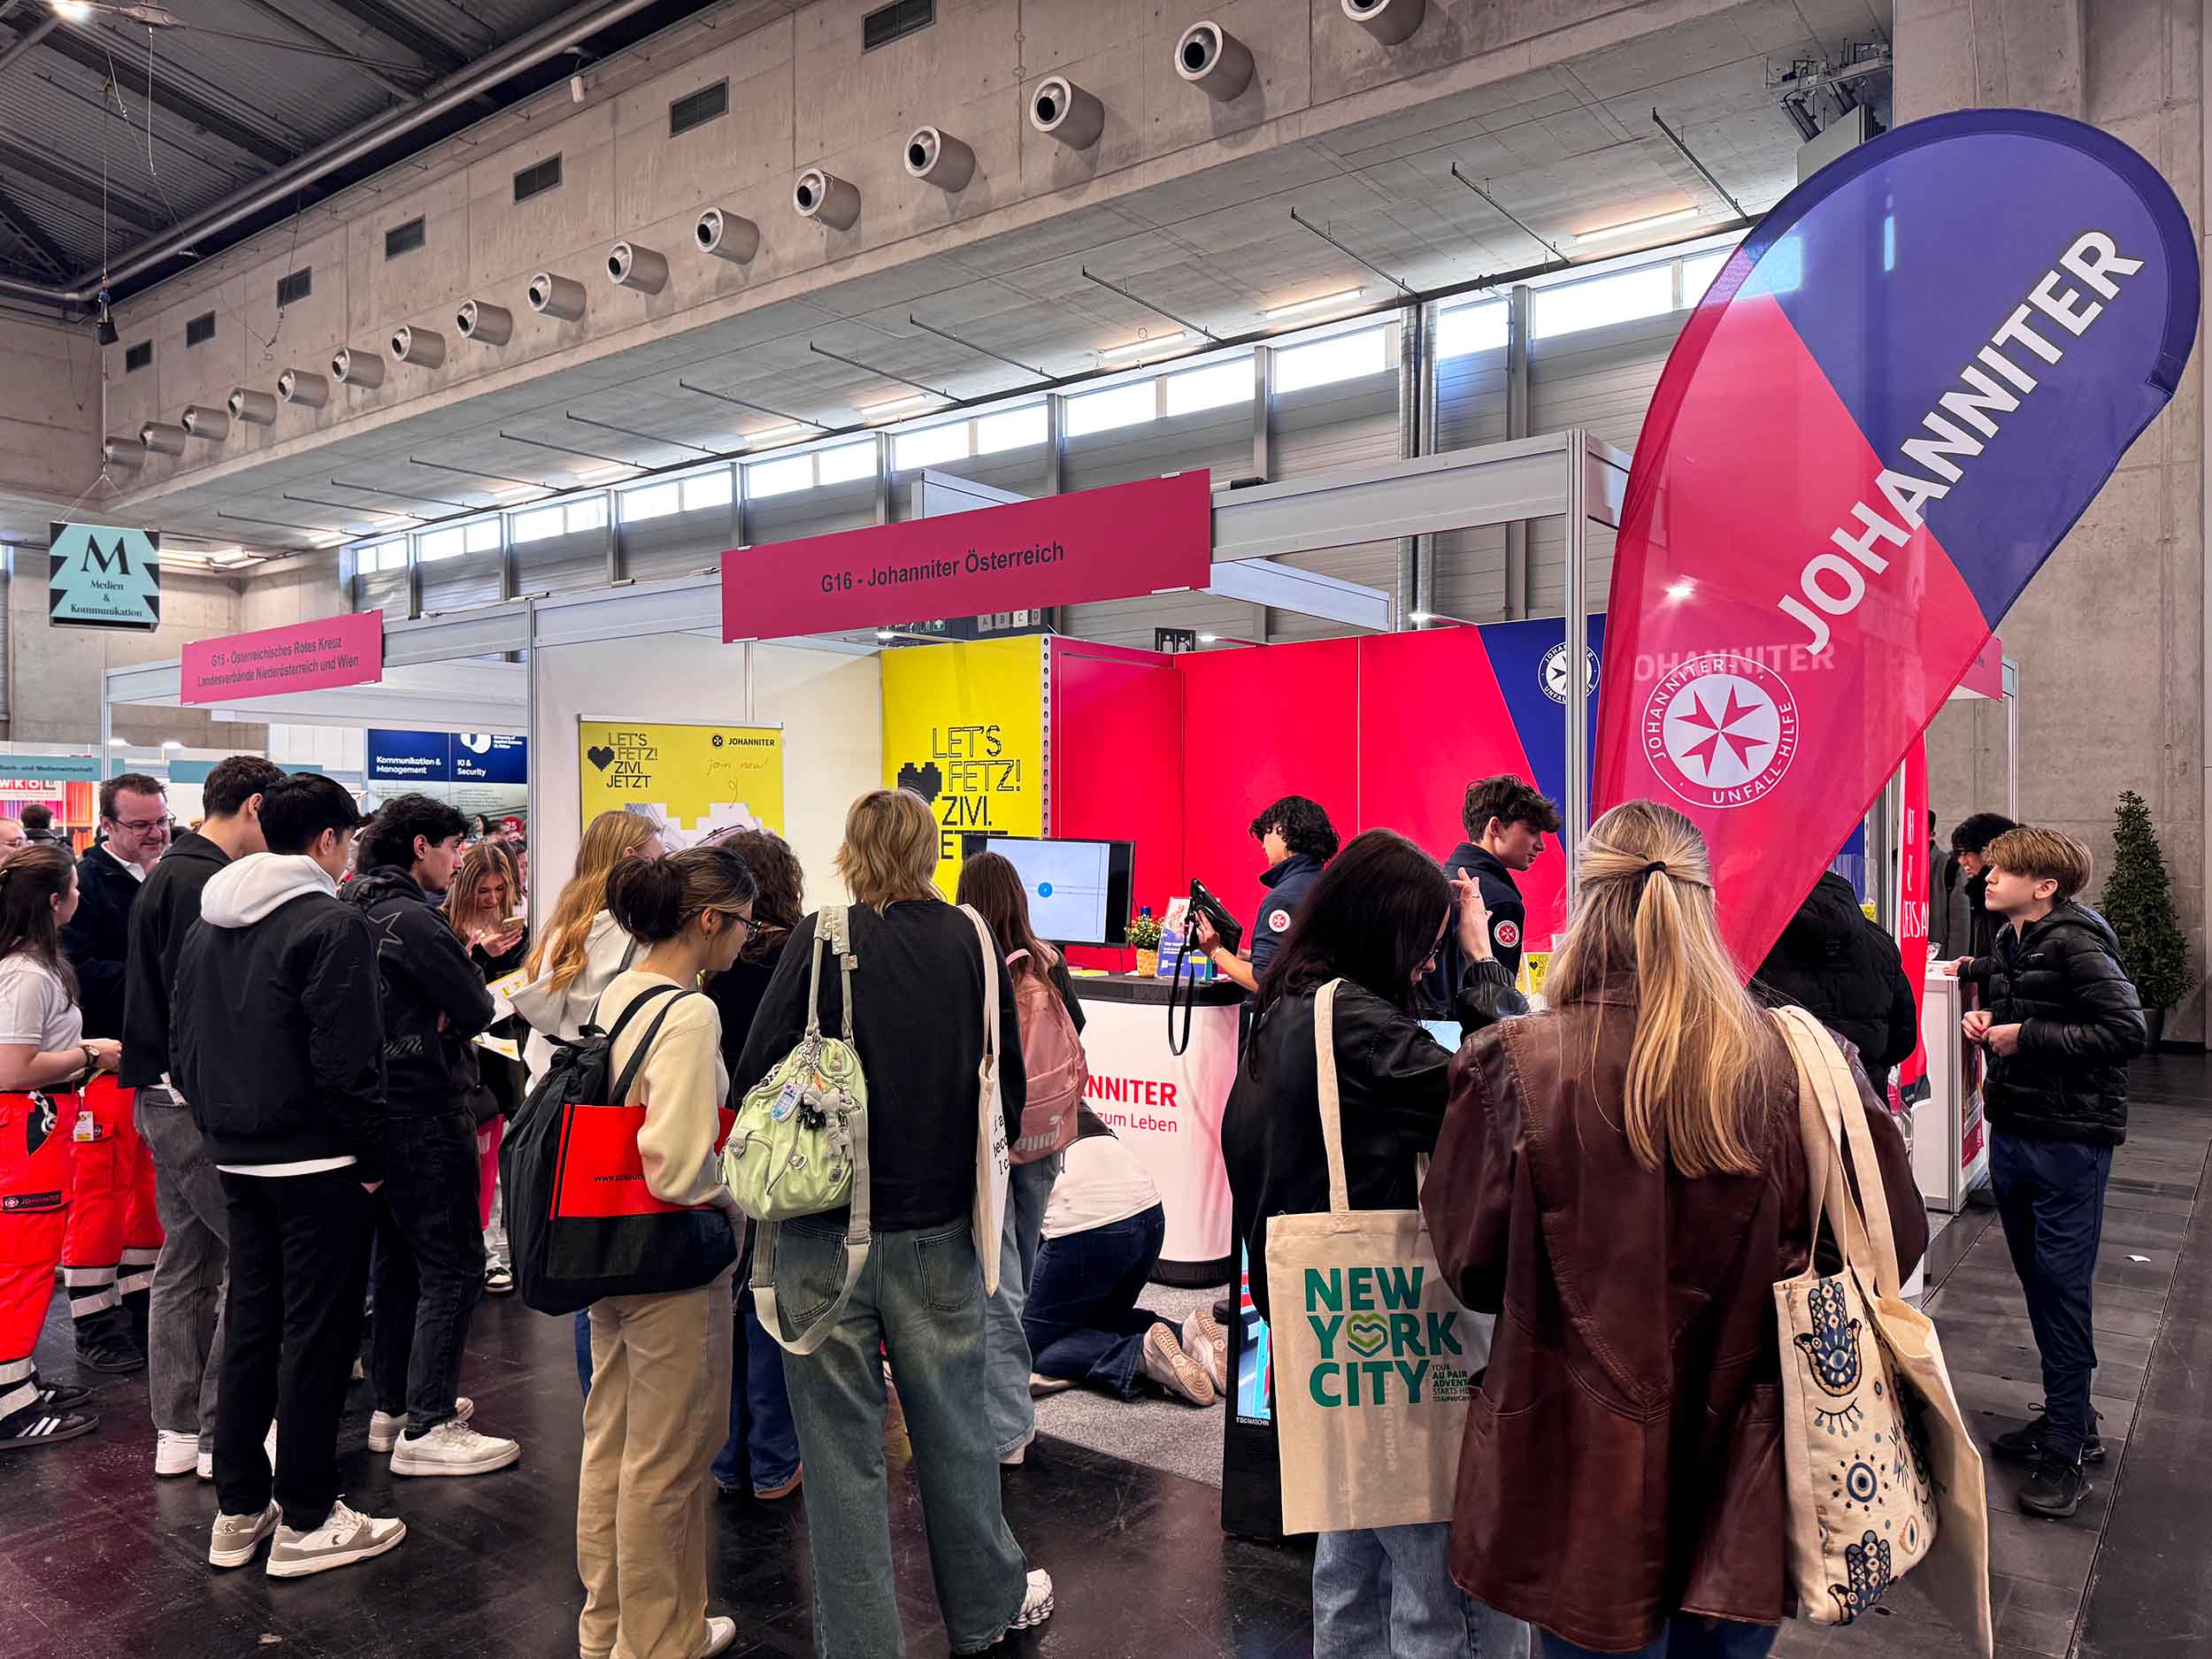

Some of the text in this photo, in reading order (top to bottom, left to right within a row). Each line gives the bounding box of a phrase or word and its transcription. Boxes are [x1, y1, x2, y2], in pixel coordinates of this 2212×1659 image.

[1778, 232, 2145, 656] JOHANNITER
[80, 534, 132, 576] M
[821, 571, 853, 593] G16
[868, 558, 960, 588] Johanniter
[965, 540, 1064, 573] Österreich
[90, 580, 124, 591] Medien
[103, 594, 111, 603] &
[71, 603, 142, 617] Kommunikation
[1018, 611, 1024, 623] C
[982, 616, 988, 626] A
[1000, 613, 1005, 624] B
[211, 652, 226, 667] G15
[231, 644, 292, 664] Österreichisches
[294, 641, 317, 656] Rotes
[319, 636, 342, 651] Kreuz
[198, 654, 358, 687] Landesverbände Niederösterreich und Wien
[609, 731, 648, 747] LET'S
[728, 737, 775, 747] JOHANNITER
[932, 724, 1002, 757] LET'S
[376, 755, 442, 766] Kommunikation &
[618, 747, 658, 761] FETZ!
[457, 758, 465, 767] KI
[614, 761, 643, 774] ZIVI.
[376, 765, 427, 776] Management
[457, 767, 487, 778] Security
[949, 759, 1022, 792] FETZ!
[606, 774, 652, 788] JETZT
[941, 795, 992, 826] ZIVI.
[1082, 1073, 1178, 1108] NNITER
[1097, 1111, 1178, 1133] zum Leben
[1303, 1266, 1425, 1313] NEW
[1309, 1359, 1431, 1408] CITY
